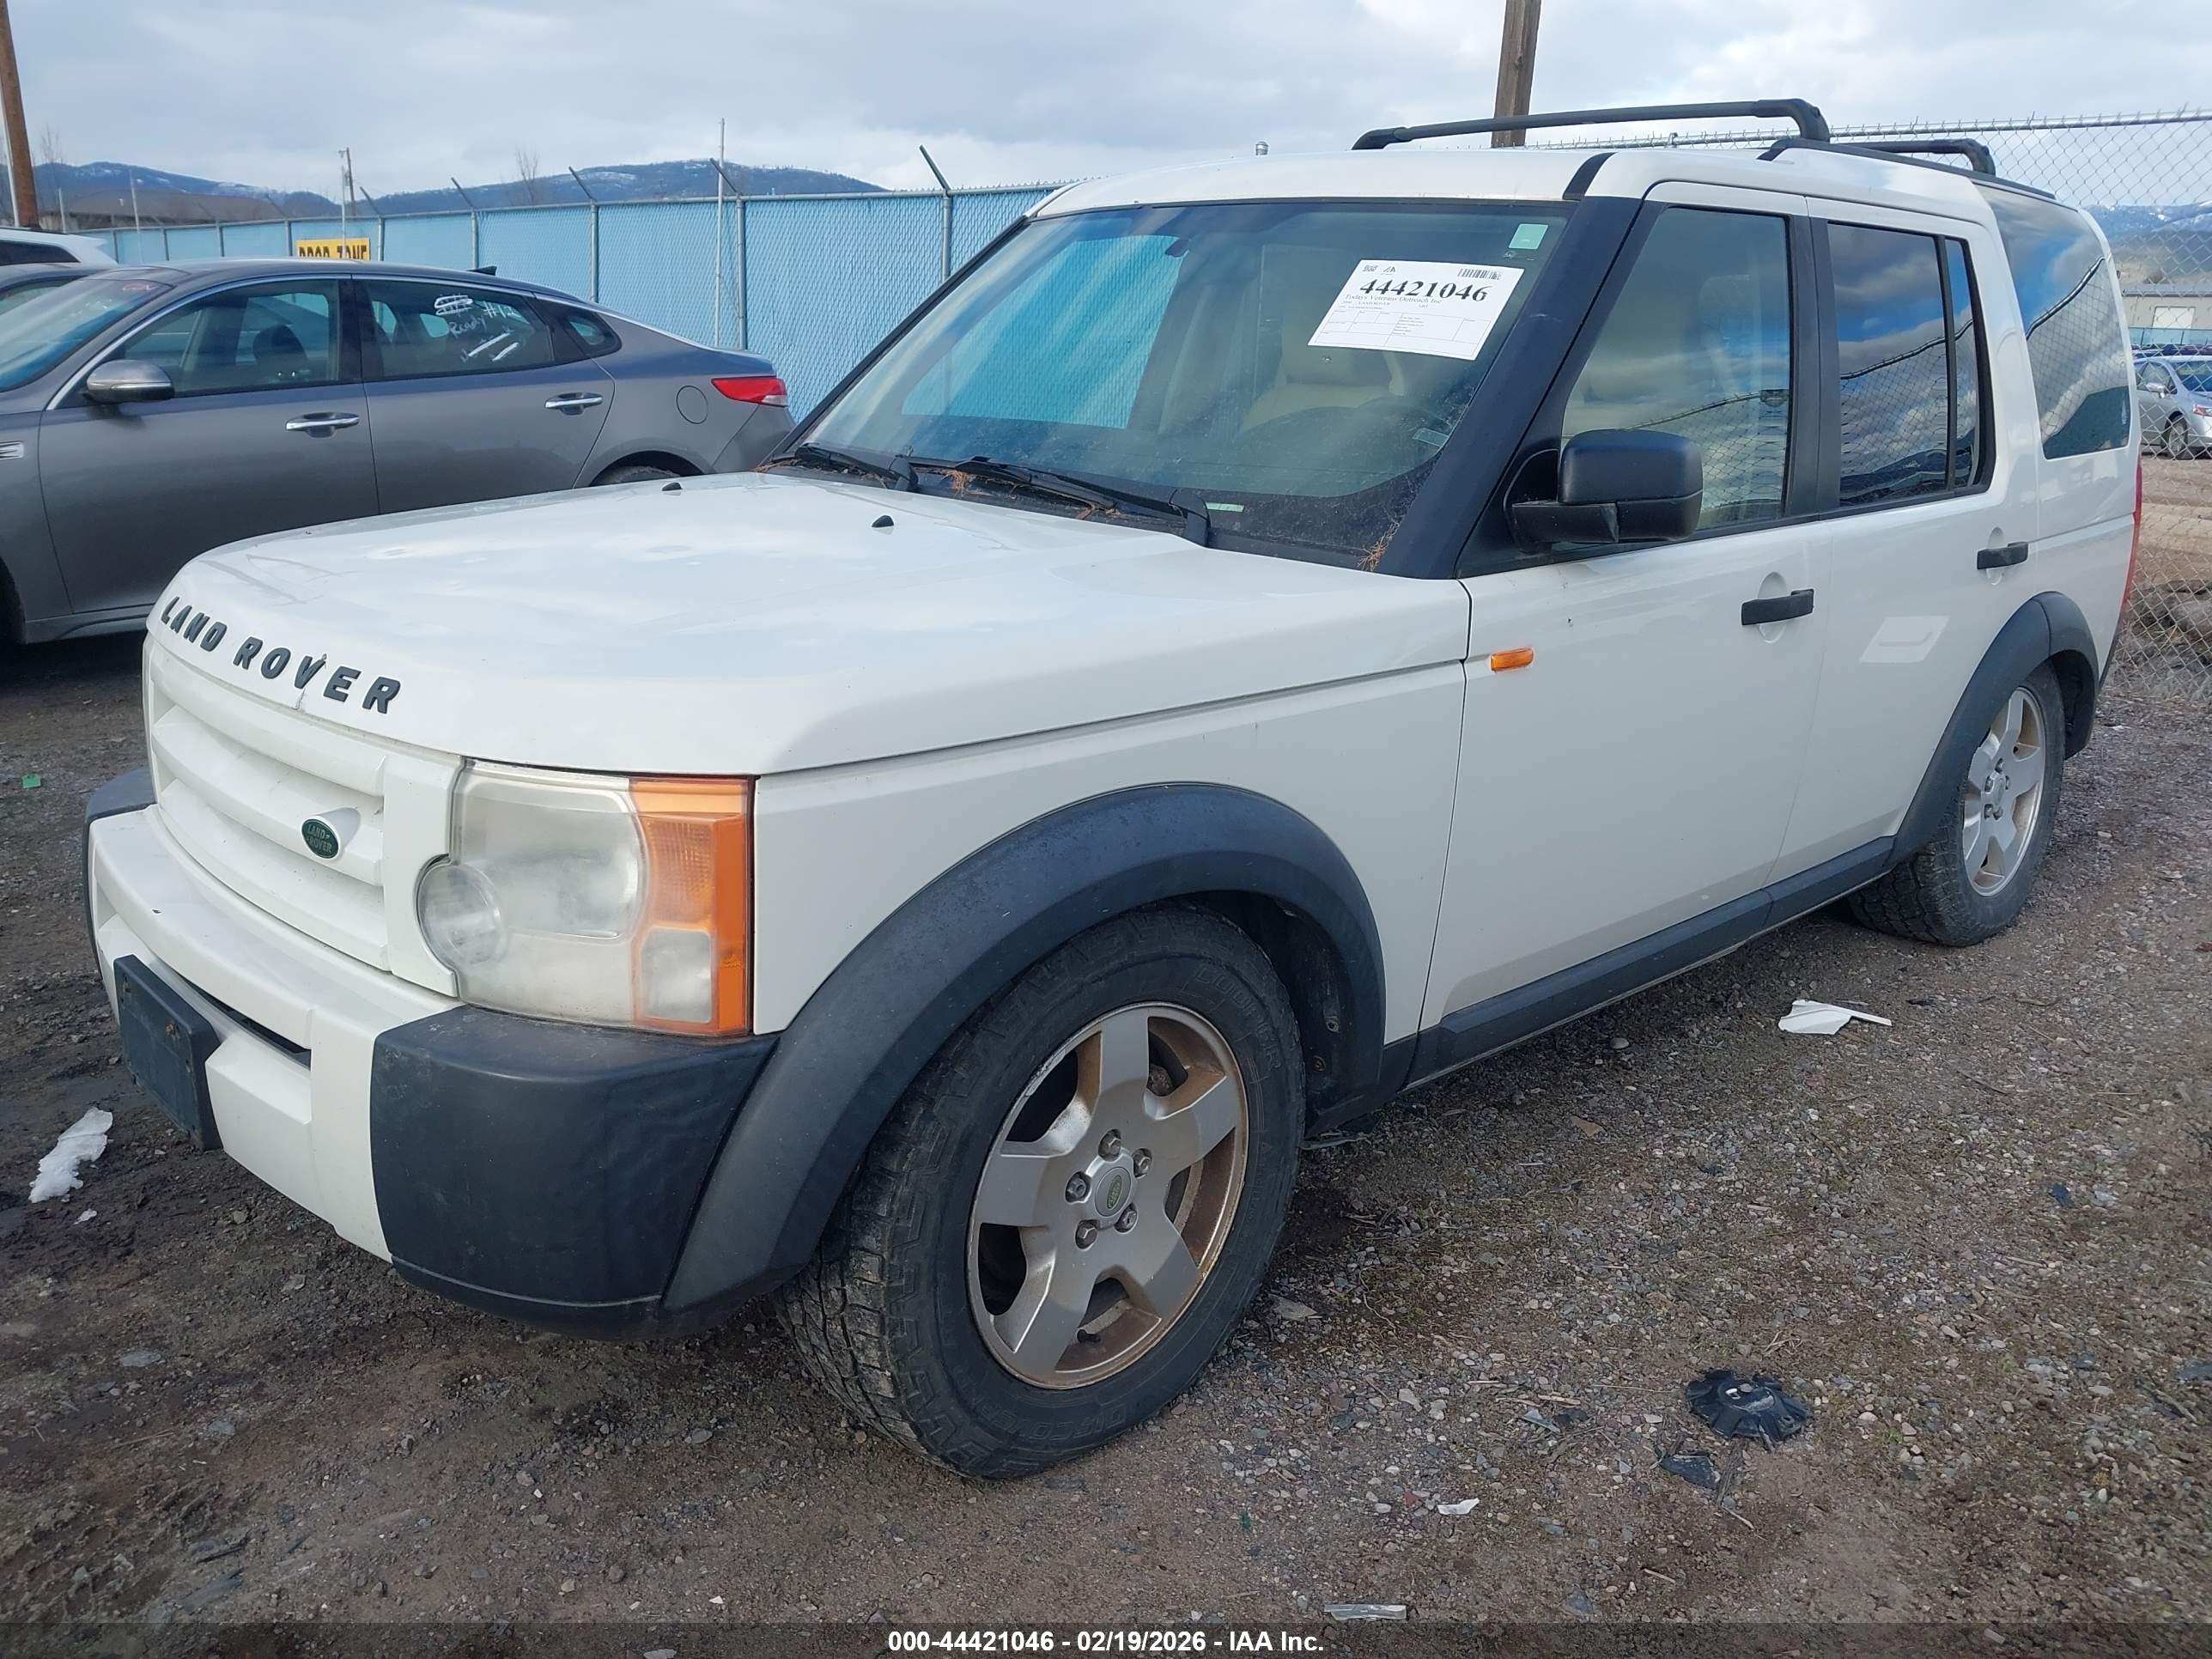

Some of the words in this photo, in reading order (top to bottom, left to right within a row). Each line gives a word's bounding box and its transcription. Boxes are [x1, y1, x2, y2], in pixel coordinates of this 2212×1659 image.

[1360, 279, 1492, 302] 44421046
[161, 596, 228, 652] LAND
[233, 636, 401, 714] ROVER
[307, 823, 326, 839] LAND
